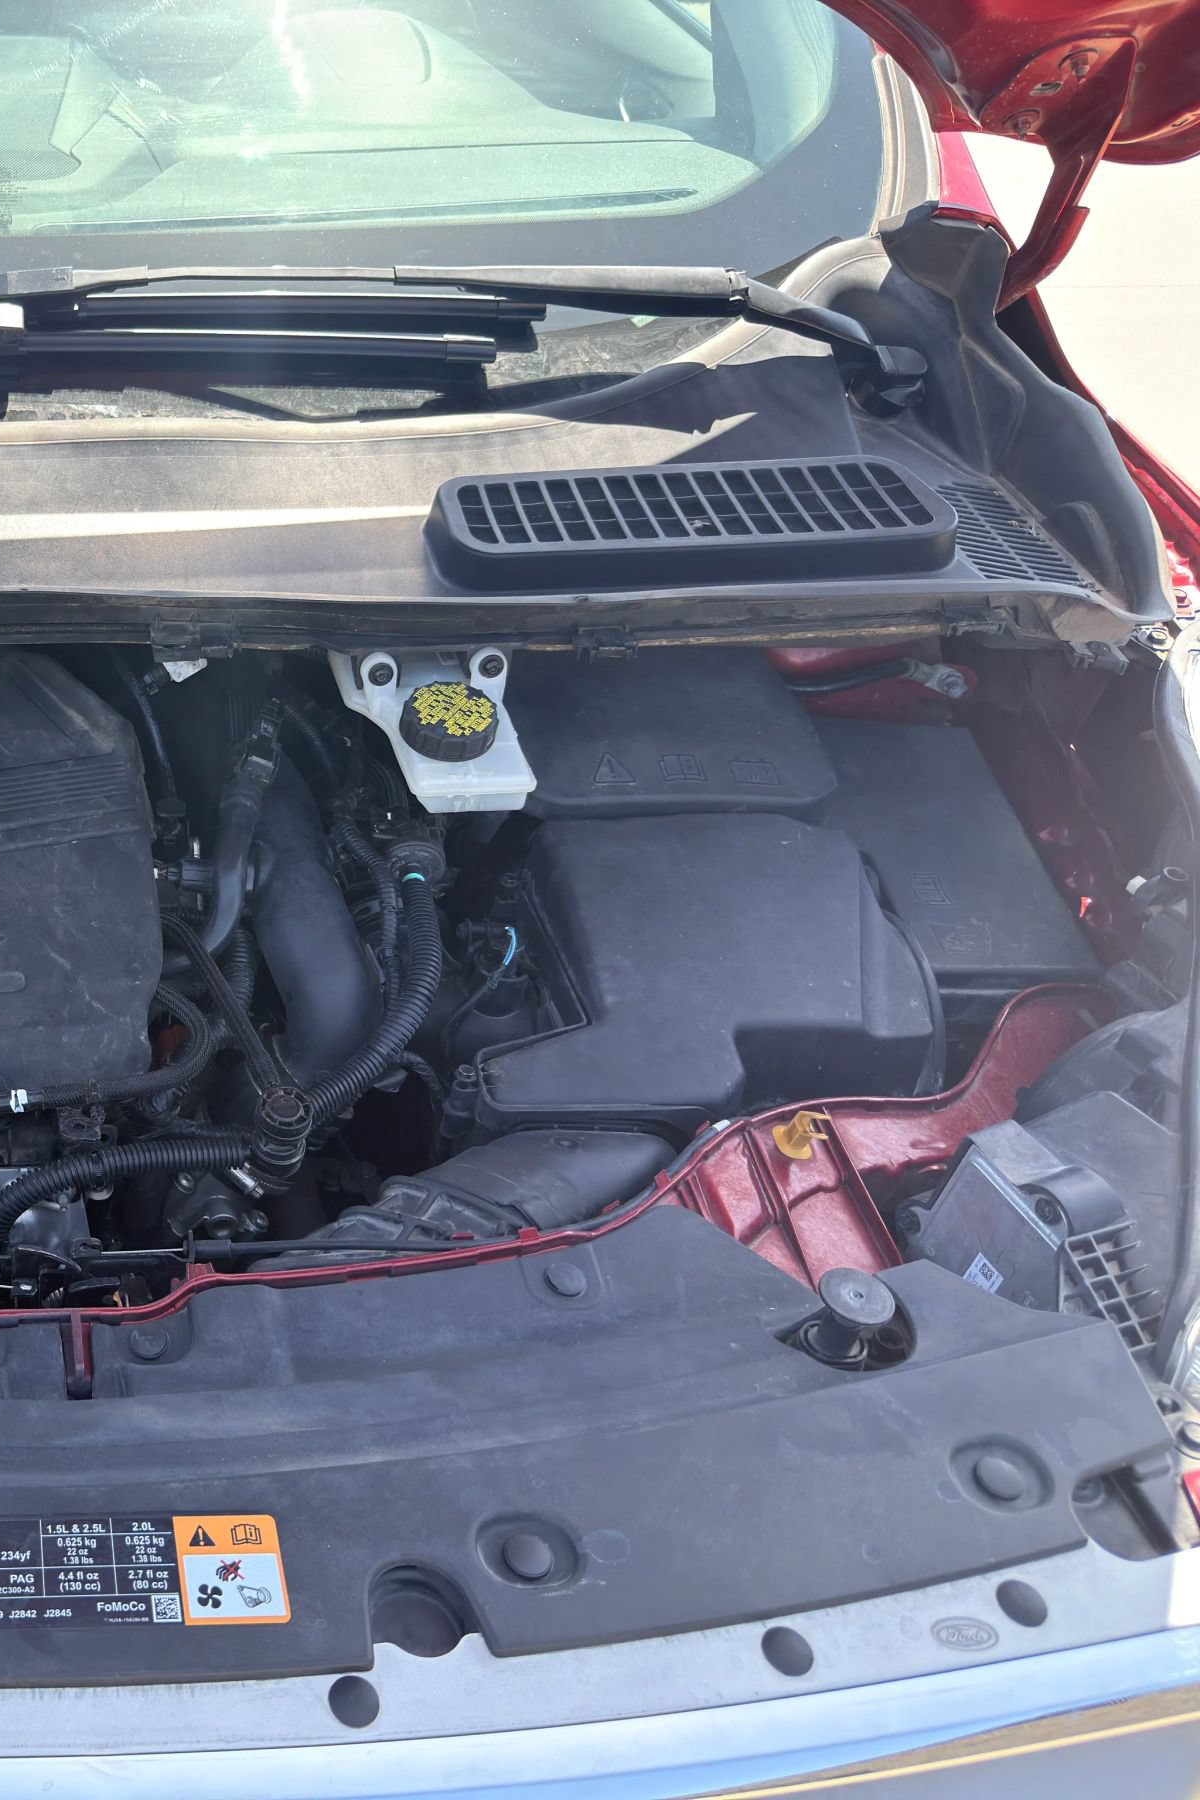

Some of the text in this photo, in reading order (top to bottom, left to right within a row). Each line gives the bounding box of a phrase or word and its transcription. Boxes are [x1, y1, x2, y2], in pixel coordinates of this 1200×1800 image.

[46, 1523, 106, 1534] 1.5L & 2.5L
[131, 1522, 156, 1531] 2.0L
[57, 1537, 97, 1548] 0.625 kg
[125, 1536, 165, 1547] 0.625 kg
[67, 1548, 78, 1556] 22
[135, 1546, 145, 1554] 22
[63, 1556, 94, 1564] 1.38 lbs
[131, 1554, 162, 1563] 1.38 lbs
[10, 1574, 35, 1584] PAG
[58, 1571, 100, 1580] 4.4 fl oz
[128, 1570, 169, 1579] 2.7 fl oz
[60, 1581, 101, 1592] (130 cc)
[133, 1580, 168, 1591] (80 cc)
[96, 1601, 146, 1612] FoMoCo
[8, 1609, 37, 1619] J2842
[43, 1608, 72, 1618] J2845
